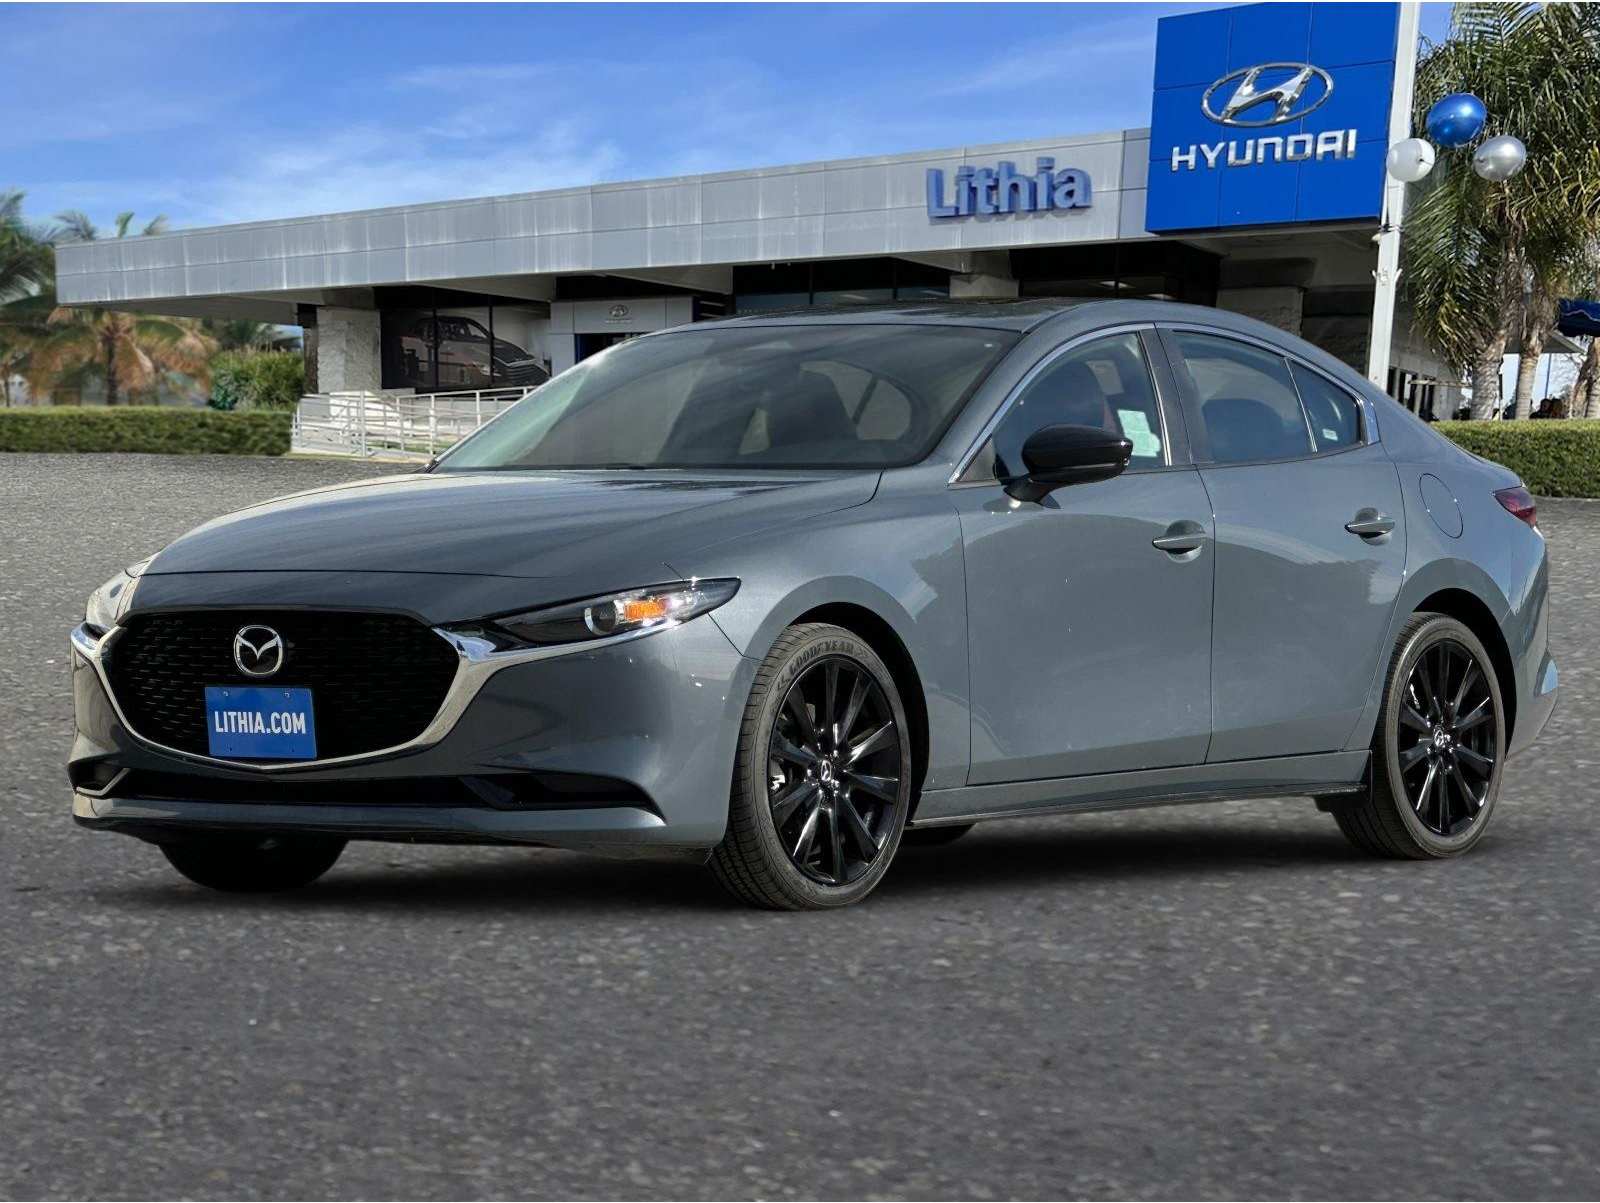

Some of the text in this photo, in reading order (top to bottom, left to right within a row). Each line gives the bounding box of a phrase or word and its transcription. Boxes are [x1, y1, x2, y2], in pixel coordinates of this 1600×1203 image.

[1171, 129, 1357, 171] HYUNDAI
[926, 156, 1092, 217] Lithia
[214, 711, 306, 734] LITHIA.COM
